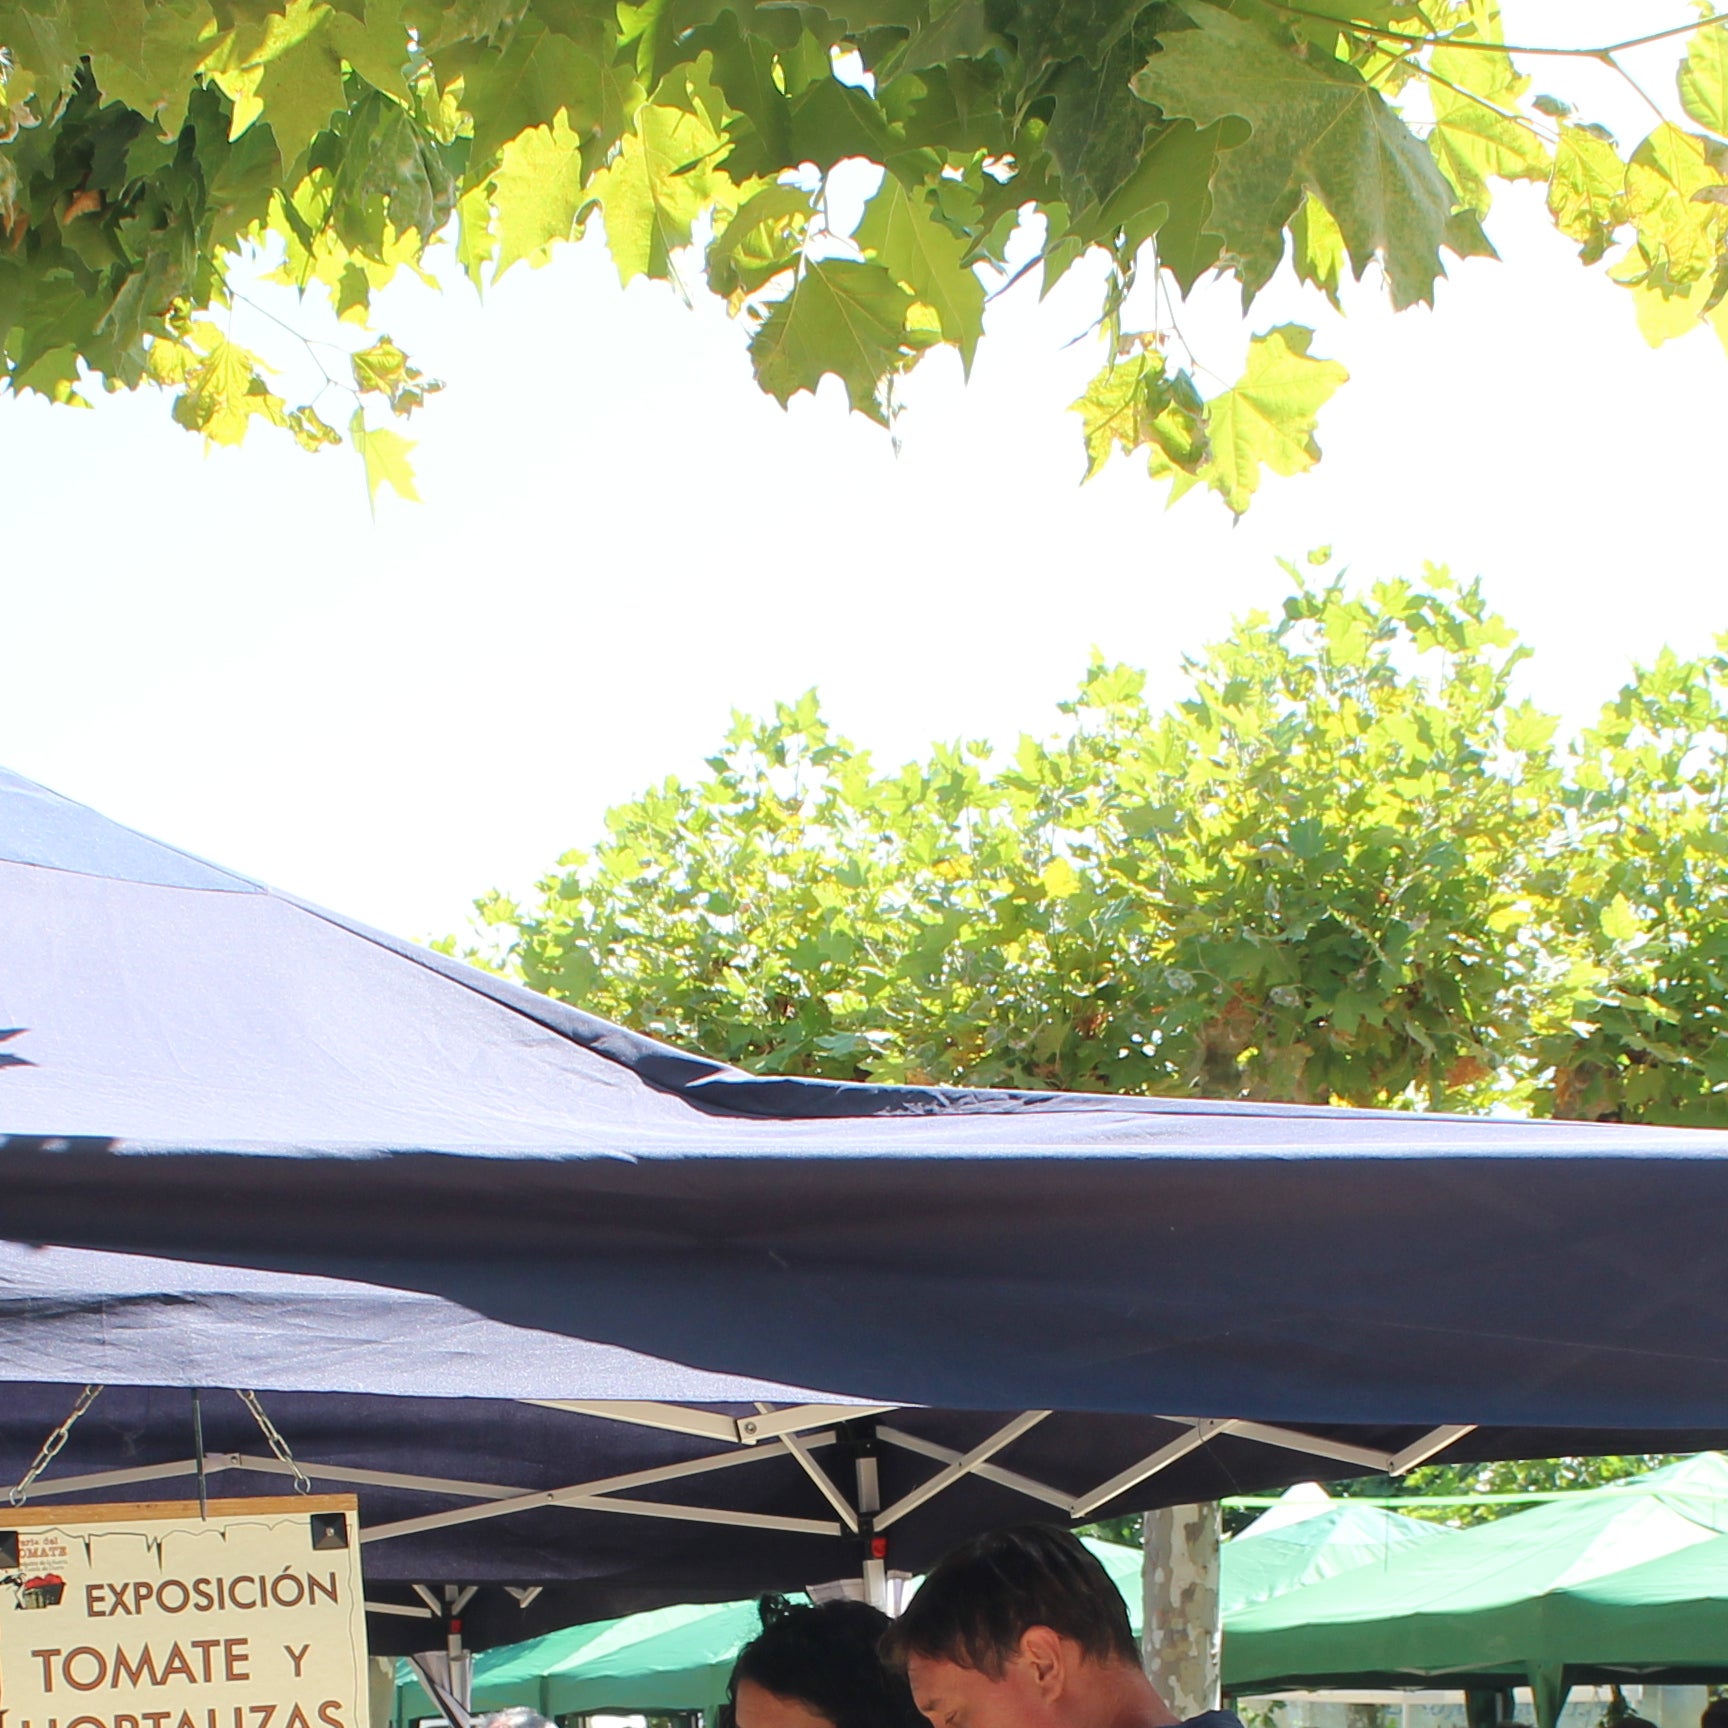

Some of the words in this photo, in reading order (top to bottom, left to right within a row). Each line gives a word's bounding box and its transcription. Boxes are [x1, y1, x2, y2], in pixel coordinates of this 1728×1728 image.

[19, 1546, 68, 1559] OMATE
[85, 1565, 340, 1618] EXPOSICIÓN
[30, 1637, 251, 1693] TOMATE
[284, 1643, 311, 1678] Y
